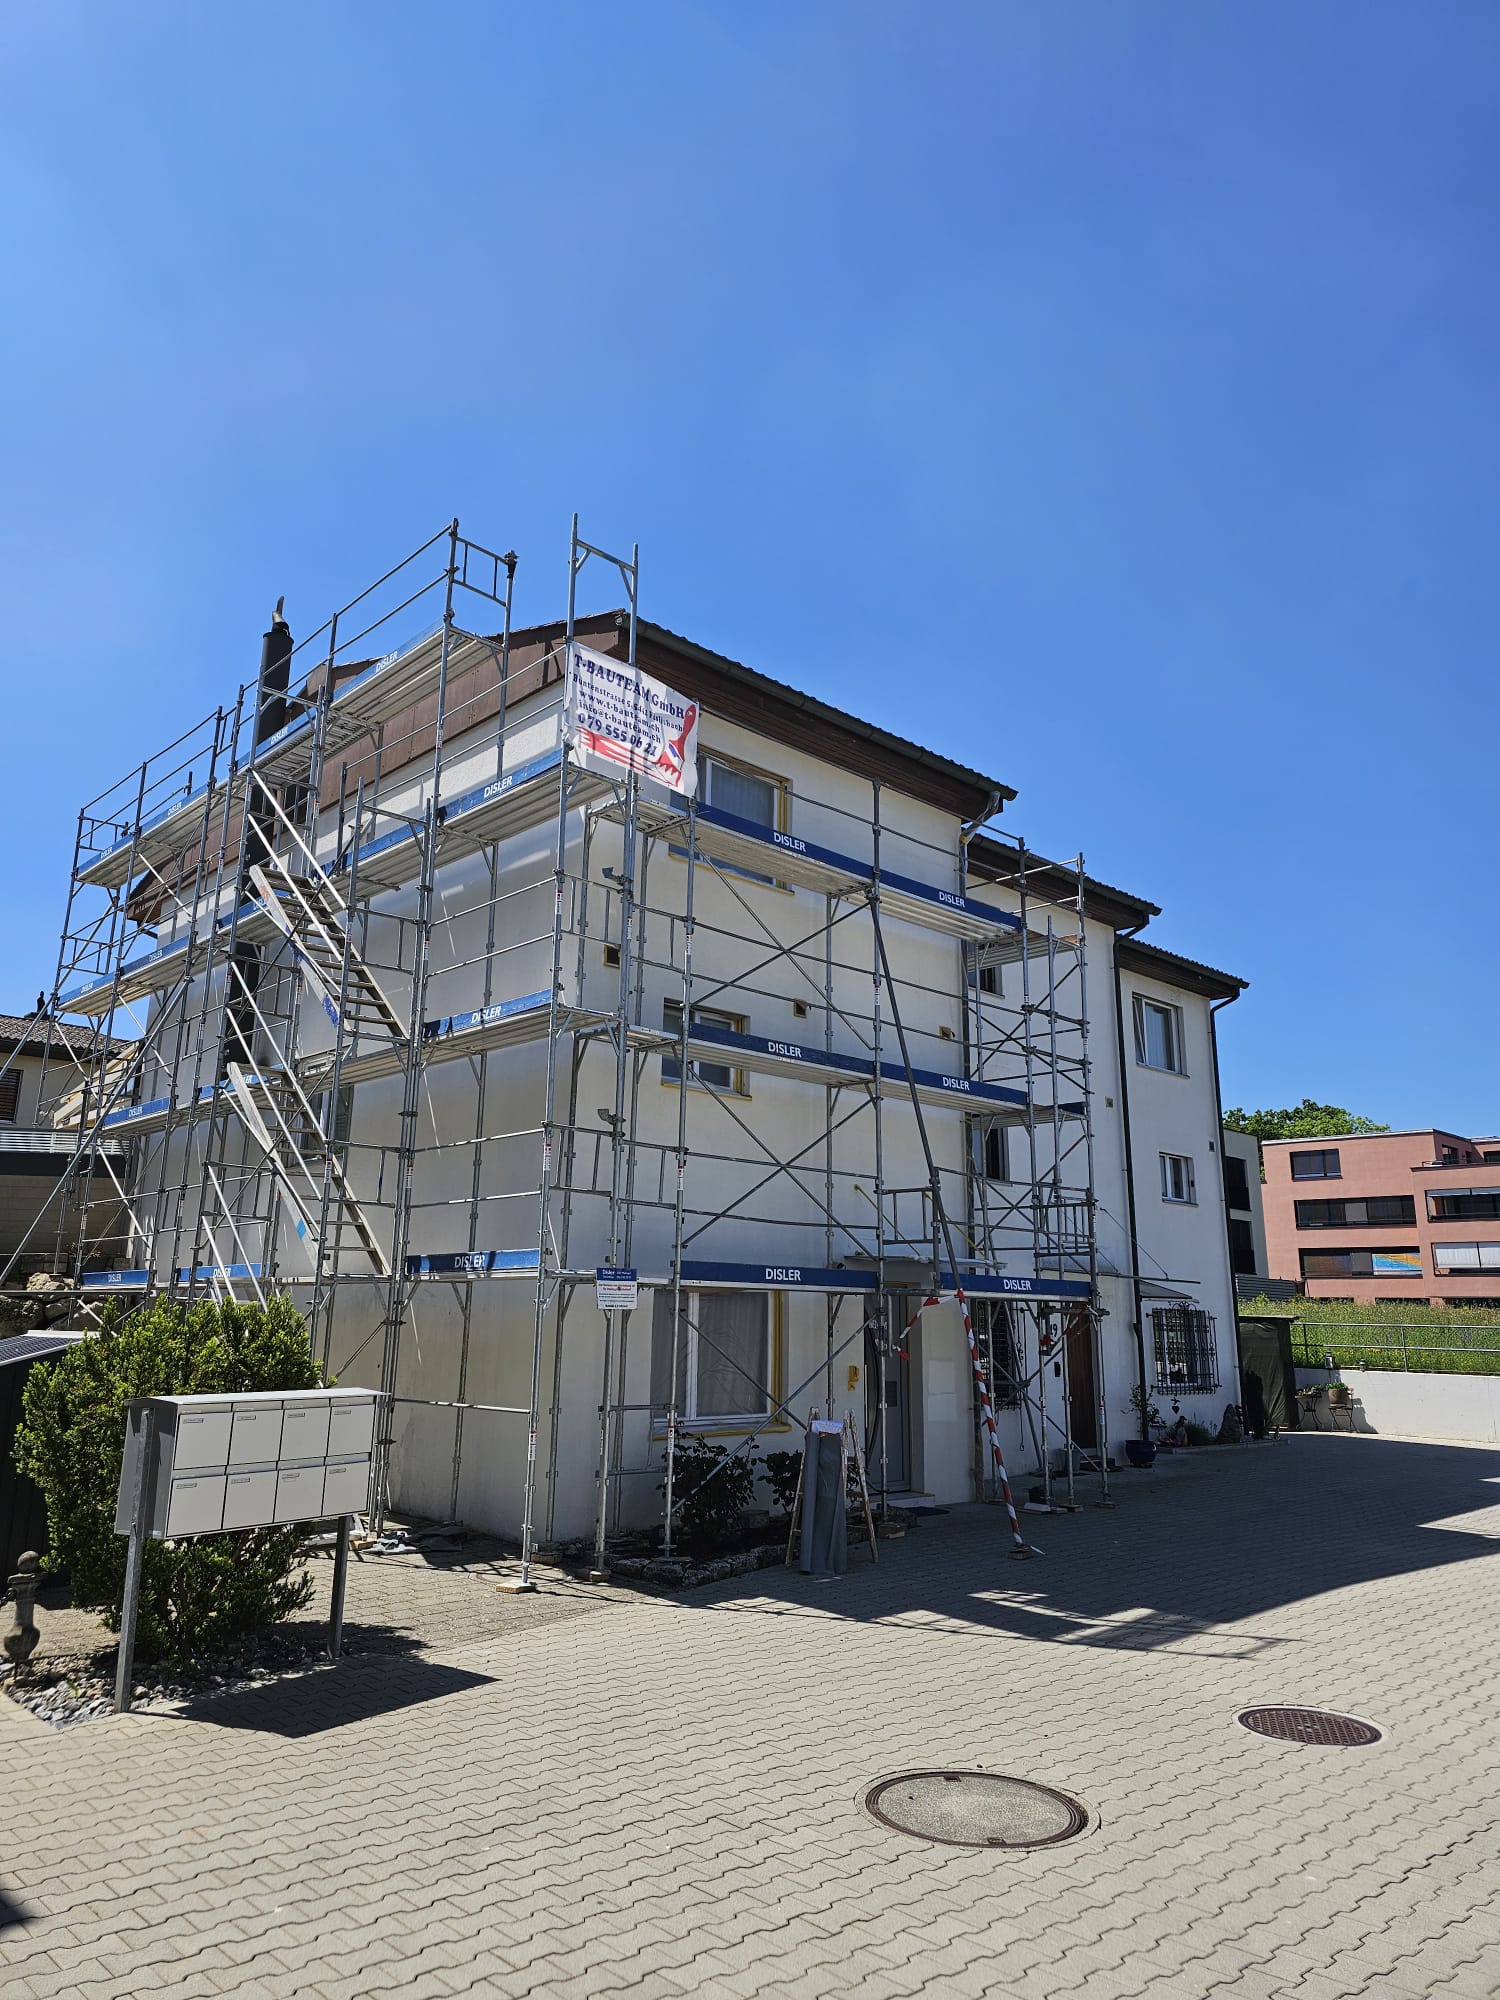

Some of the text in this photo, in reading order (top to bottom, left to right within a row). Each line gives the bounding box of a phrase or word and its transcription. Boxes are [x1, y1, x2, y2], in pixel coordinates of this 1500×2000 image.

[375, 651, 398, 673] DISLER
[574, 653, 684, 719] T-BAUTEAM GmbH
[270, 727, 288, 745] DISLER
[578, 713, 657, 757] 079 555 06 21
[483, 775, 513, 798] DISLER
[167, 802, 182, 816] DISLER
[773, 832, 806, 853] DISLER
[939, 891, 966, 908] DISLER
[148, 949, 163, 962] DISLER
[471, 1006, 501, 1024] DISLER
[768, 1041, 803, 1058] DISLER
[942, 1077, 970, 1091] DISLER
[128, 1105, 143, 1118] DISLER
[454, 1255, 486, 1269] DISLER
[765, 1268, 801, 1281] DISLER
[1003, 1279, 1032, 1291] DISLER
